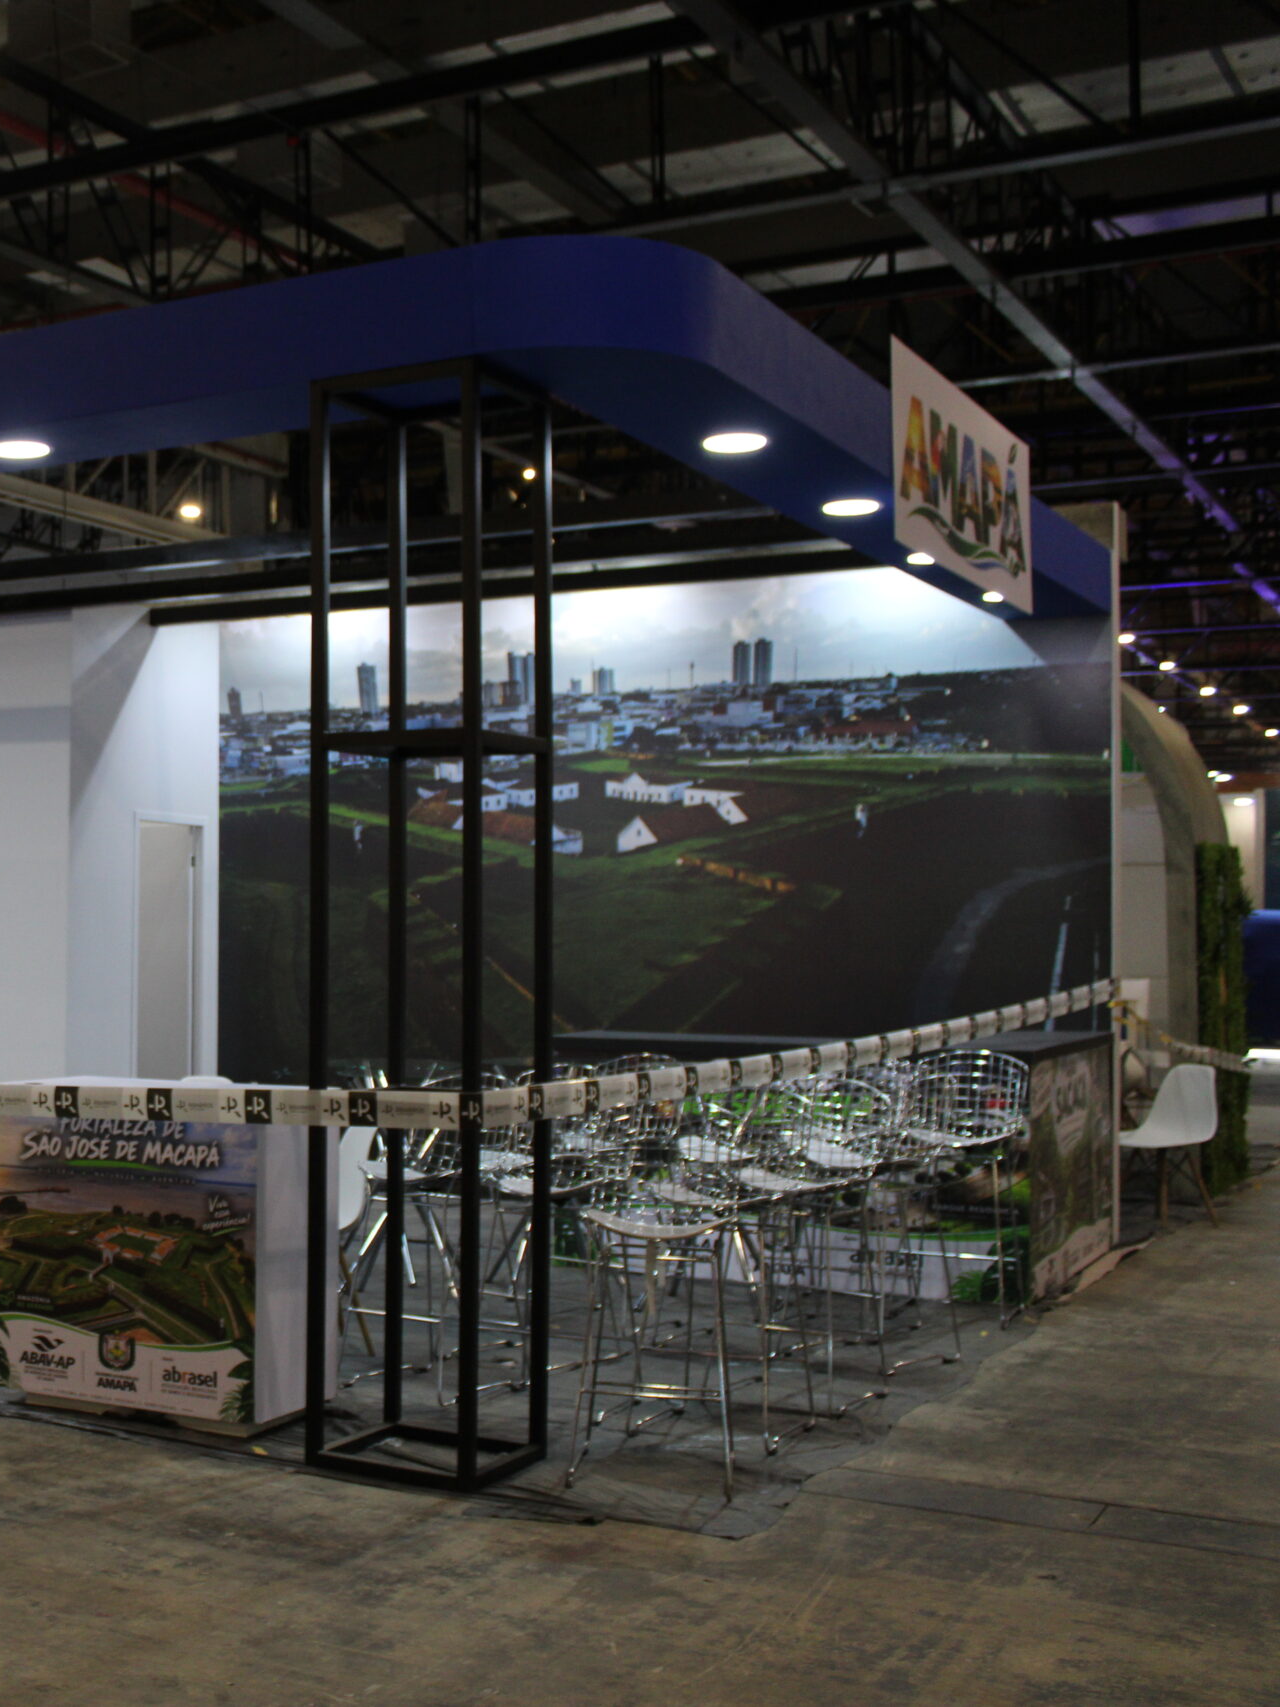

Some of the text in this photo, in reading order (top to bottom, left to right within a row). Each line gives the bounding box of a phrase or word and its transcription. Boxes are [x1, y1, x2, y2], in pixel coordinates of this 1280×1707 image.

[899, 394, 1026, 573] AMAPÁ
[162, 1120, 185, 1139] DE
[19, 1128, 220, 1168] SÃO JOSÉ DE MACAPÁ
[19, 1350, 76, 1369] ABAV-AP
[161, 1365, 218, 1388] abrasel
